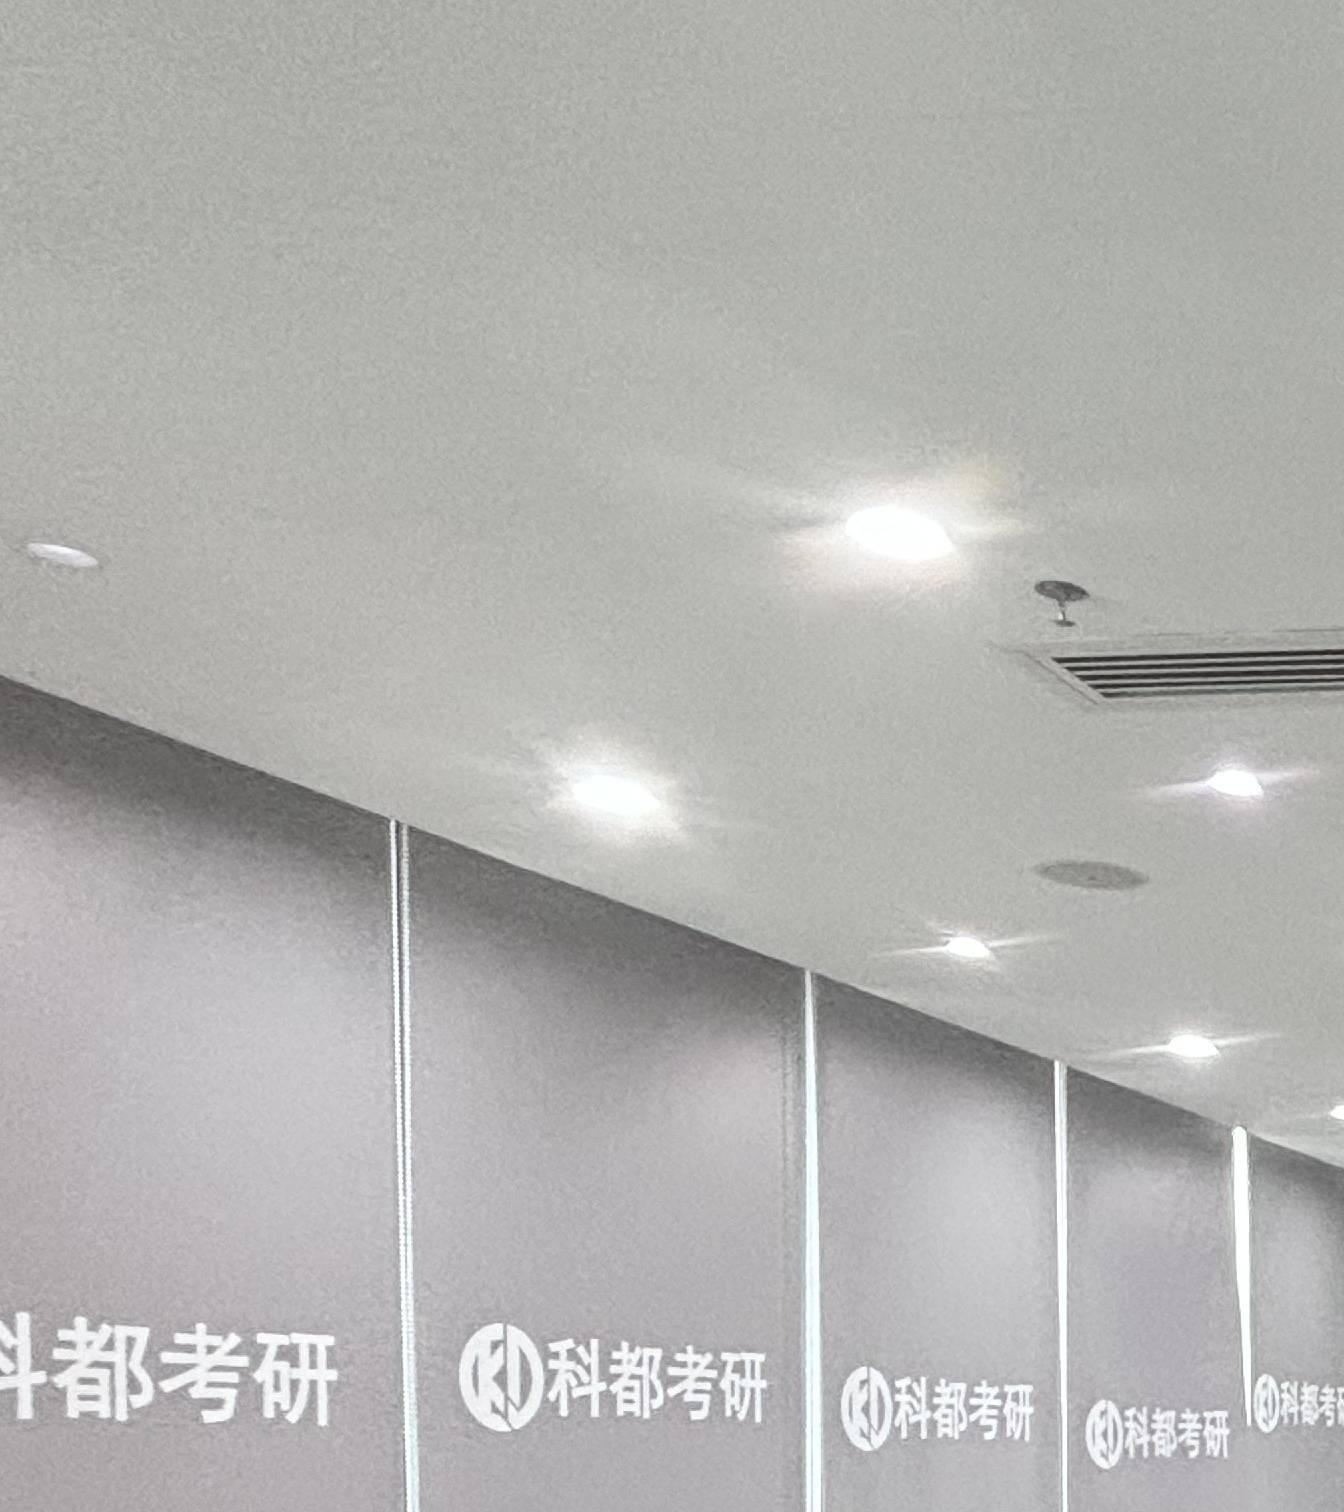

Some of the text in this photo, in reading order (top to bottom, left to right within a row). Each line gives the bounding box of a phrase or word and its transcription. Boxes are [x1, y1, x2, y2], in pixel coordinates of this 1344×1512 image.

[547, 1337, 768, 1424] 科都考研
[893, 1375, 1035, 1443] 科都考研
[1124, 1405, 1231, 1461] 科都考研
